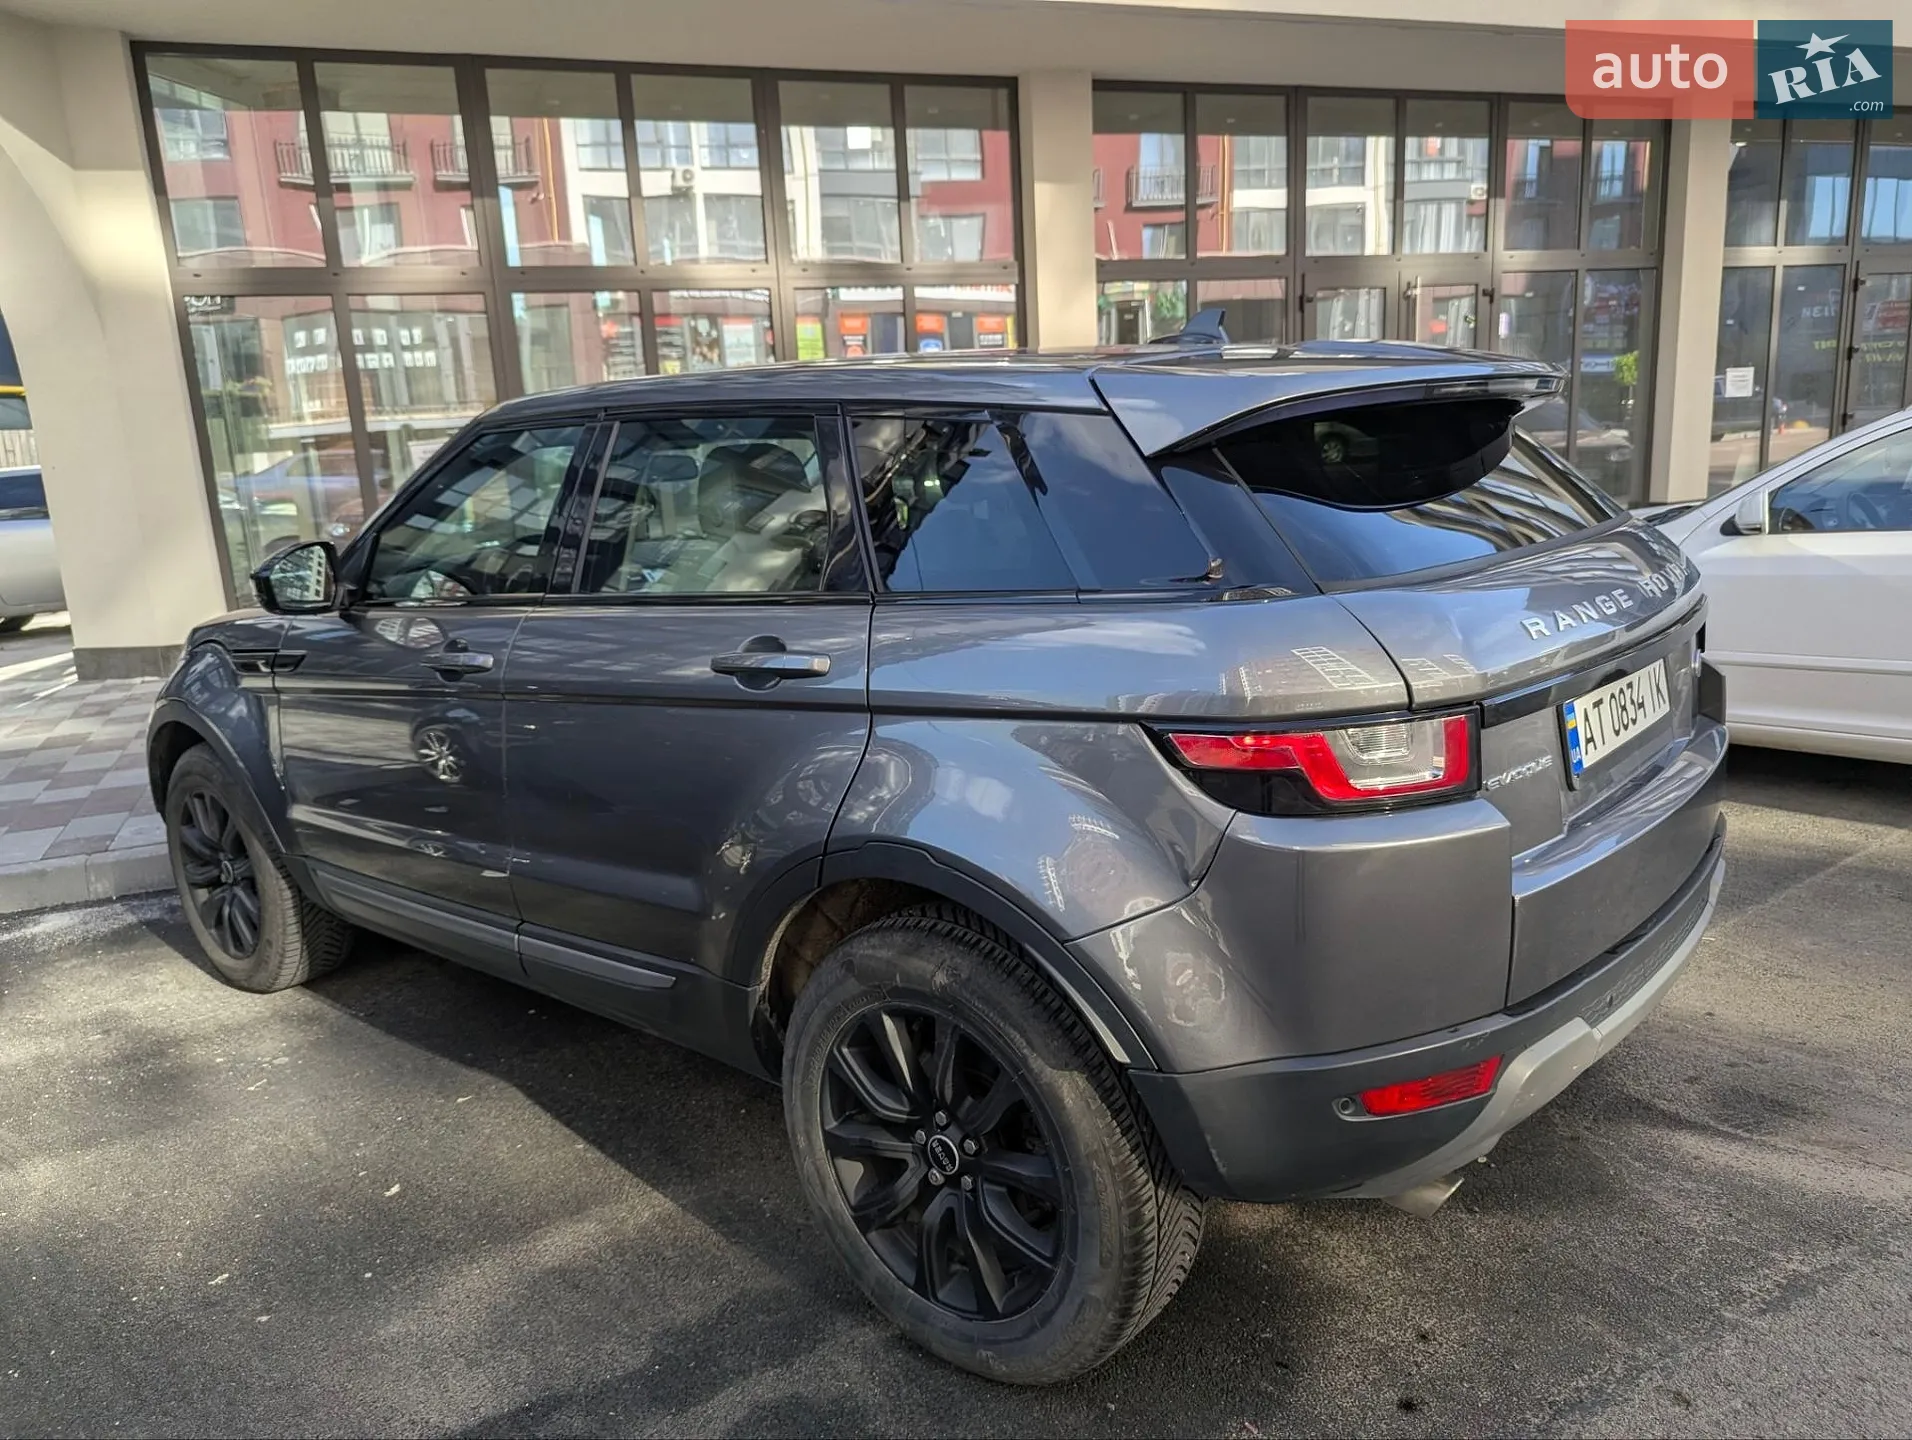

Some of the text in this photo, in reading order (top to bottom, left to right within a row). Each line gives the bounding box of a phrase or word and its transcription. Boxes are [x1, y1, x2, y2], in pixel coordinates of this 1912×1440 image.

[1521, 589, 1634, 640] RANGE
[1584, 663, 1666, 756] AT 0834 IK
[1570, 746, 1582, 763] UA
